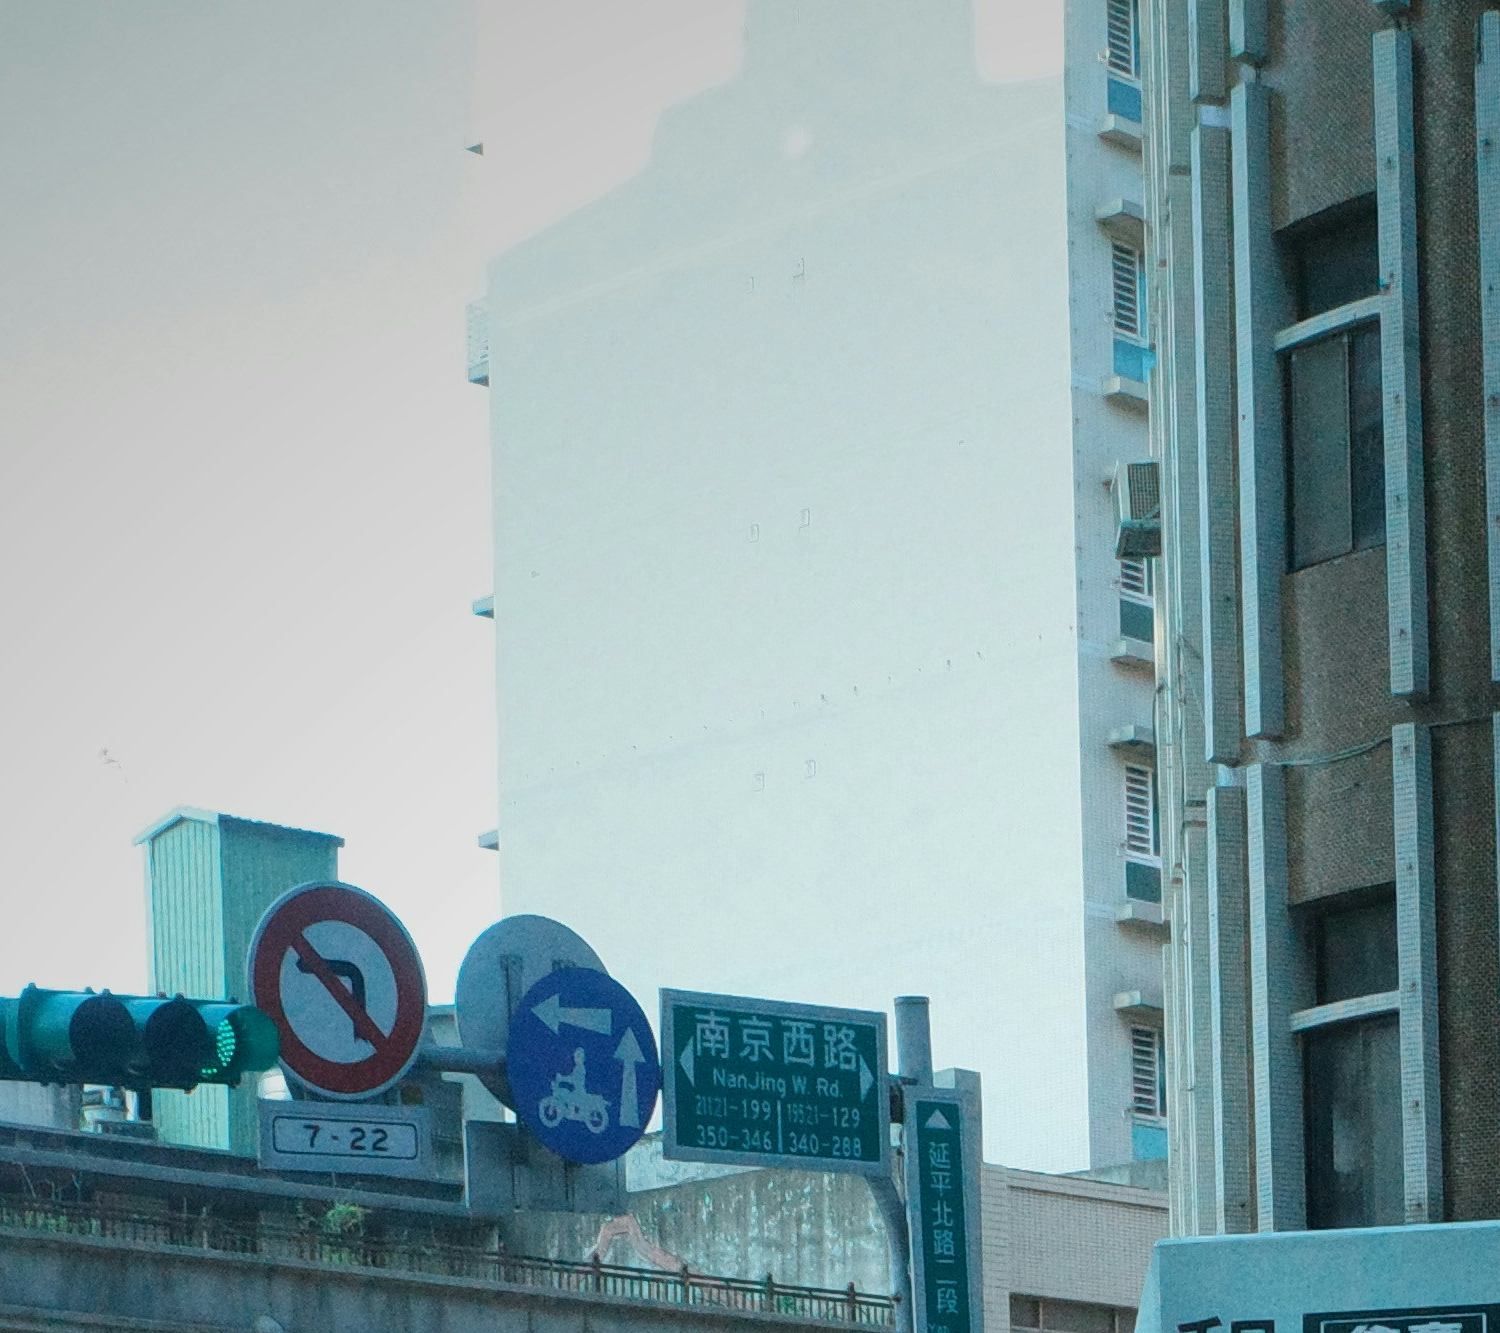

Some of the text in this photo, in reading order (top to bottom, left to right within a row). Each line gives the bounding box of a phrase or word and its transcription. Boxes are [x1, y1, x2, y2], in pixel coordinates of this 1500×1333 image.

[695, 1010, 858, 1072] 南京西路
[712, 1067, 844, 1099] NanJing W. Rd.
[696, 1125, 863, 1158] 350-346 340-288
[928, 1141, 958, 1314] 延平北路二段
